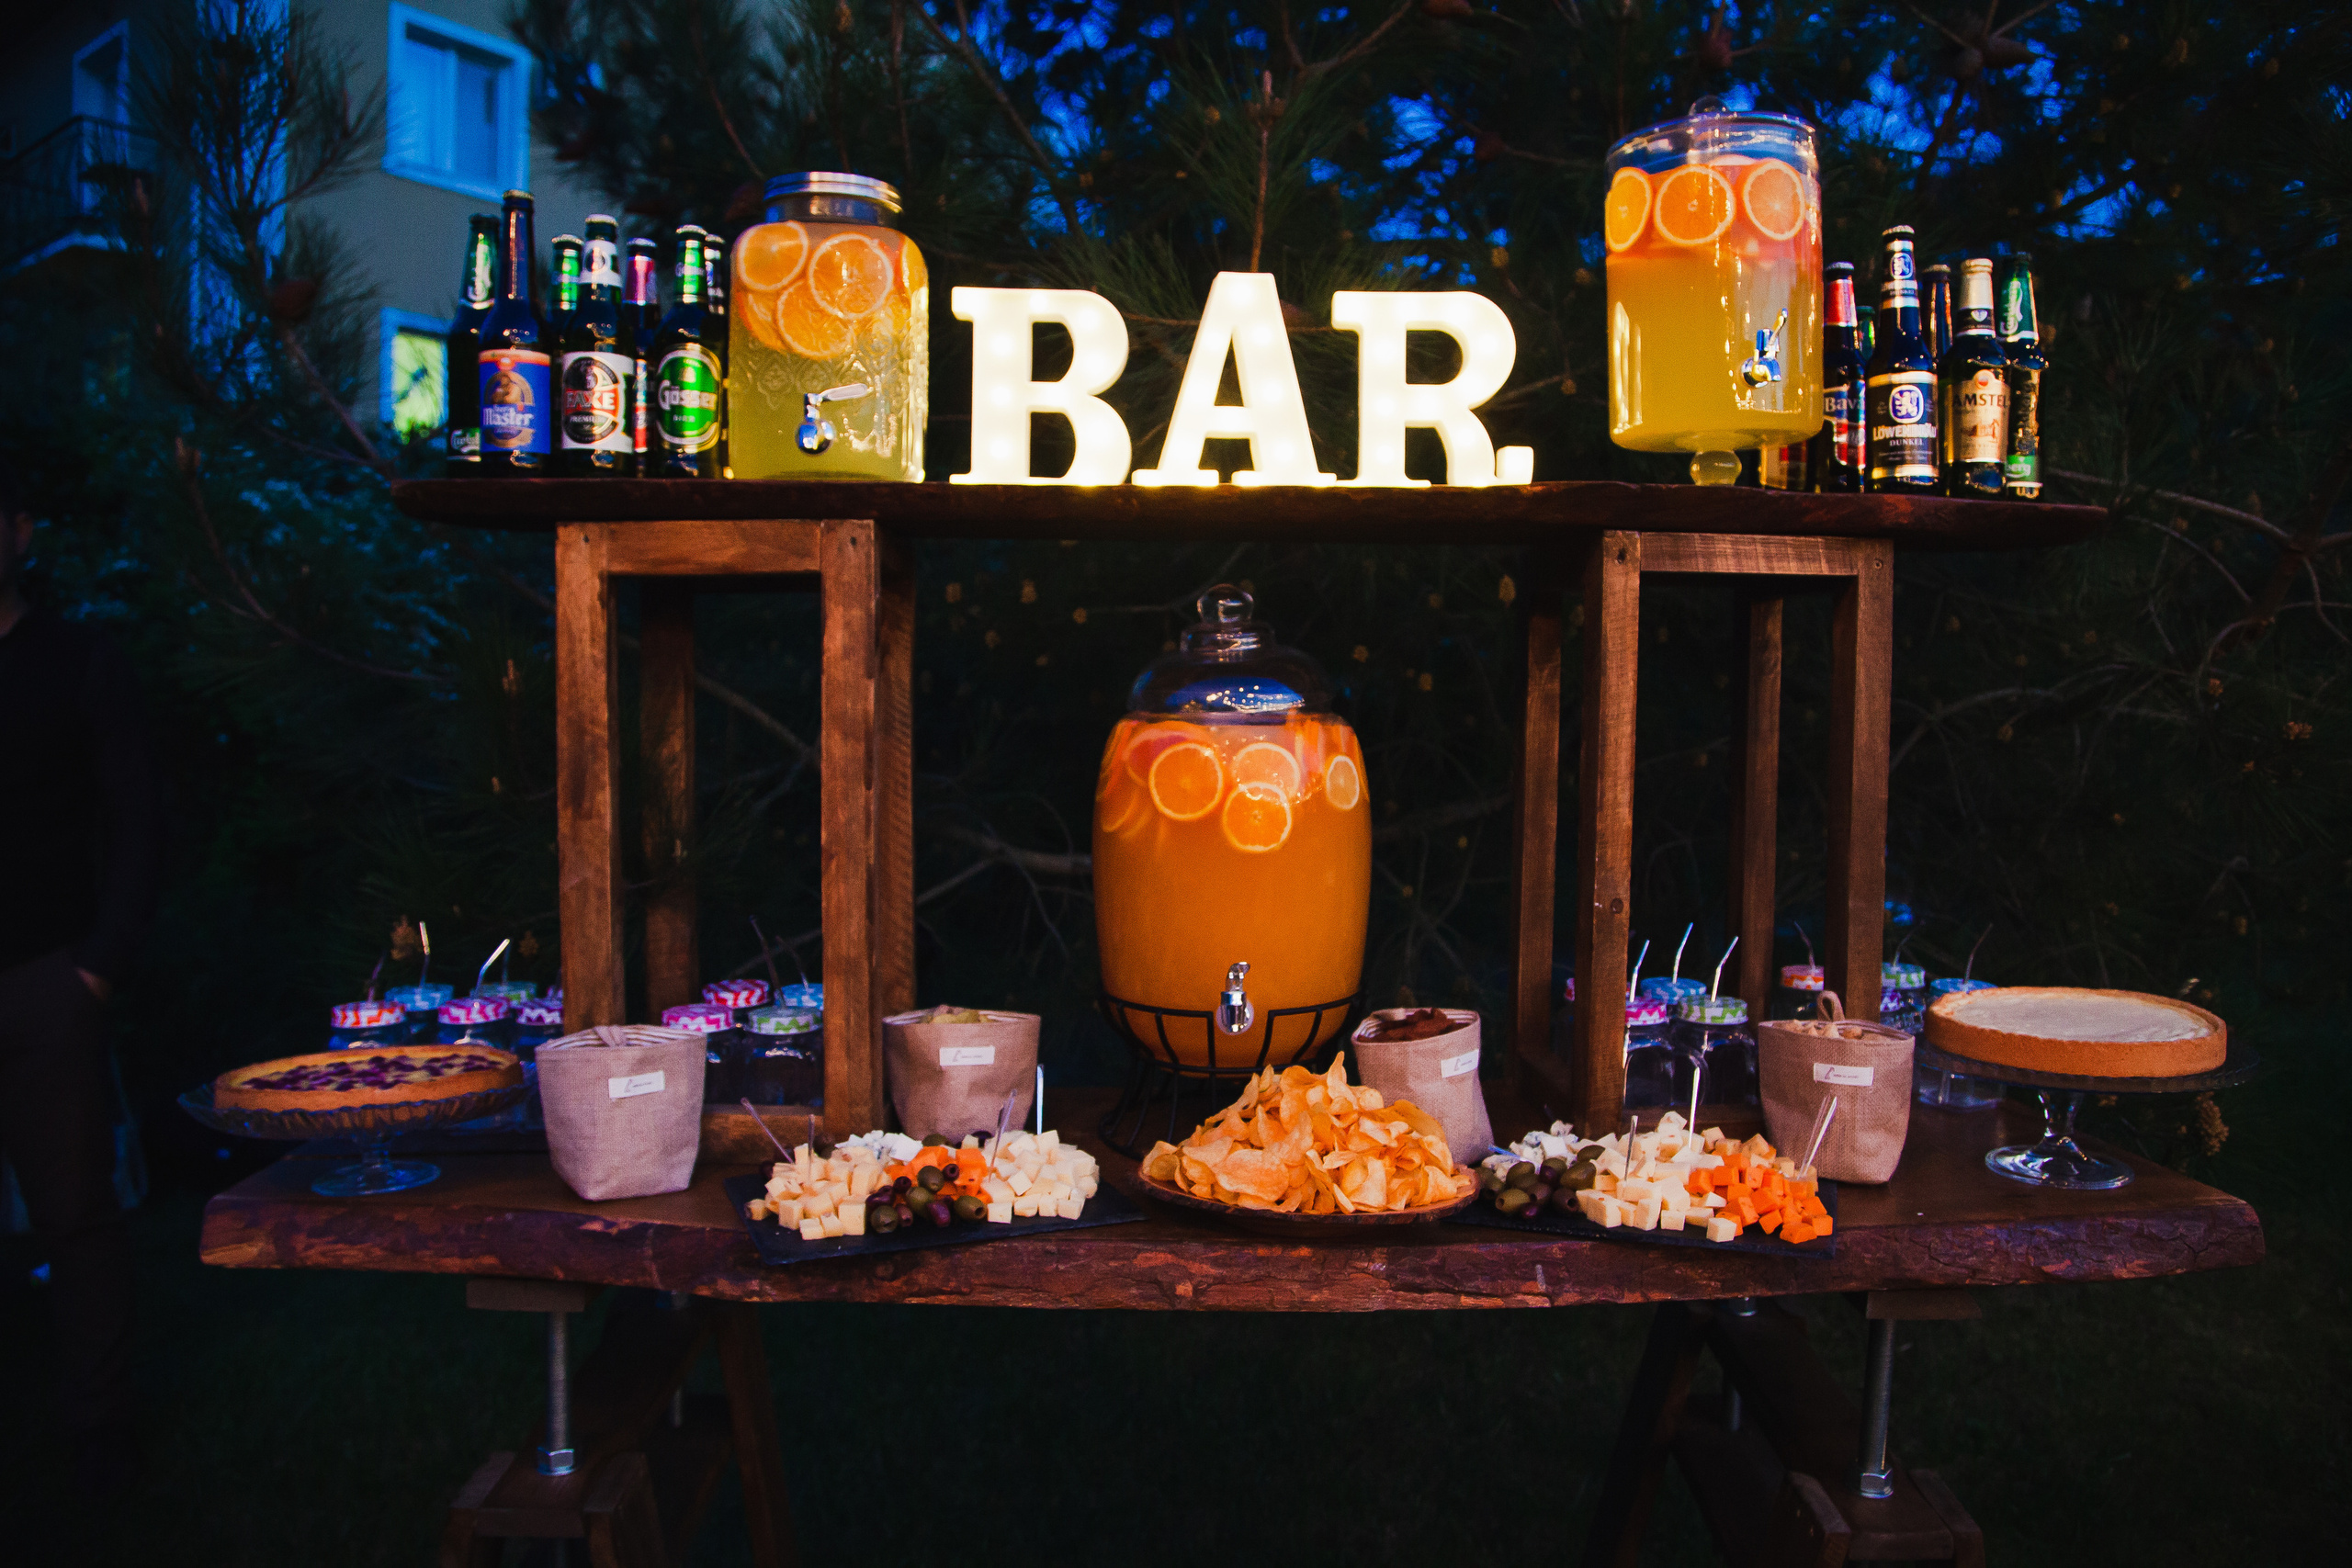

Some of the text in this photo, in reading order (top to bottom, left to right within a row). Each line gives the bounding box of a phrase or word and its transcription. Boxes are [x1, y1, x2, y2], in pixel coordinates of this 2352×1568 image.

[949, 271, 1534, 487] BAR
[566, 390, 616, 411] FAXE
[1953, 392, 2007, 408] AMSTEL
[482, 407, 535, 427] Master
[1889, 439, 1924, 447] DUNKEL
